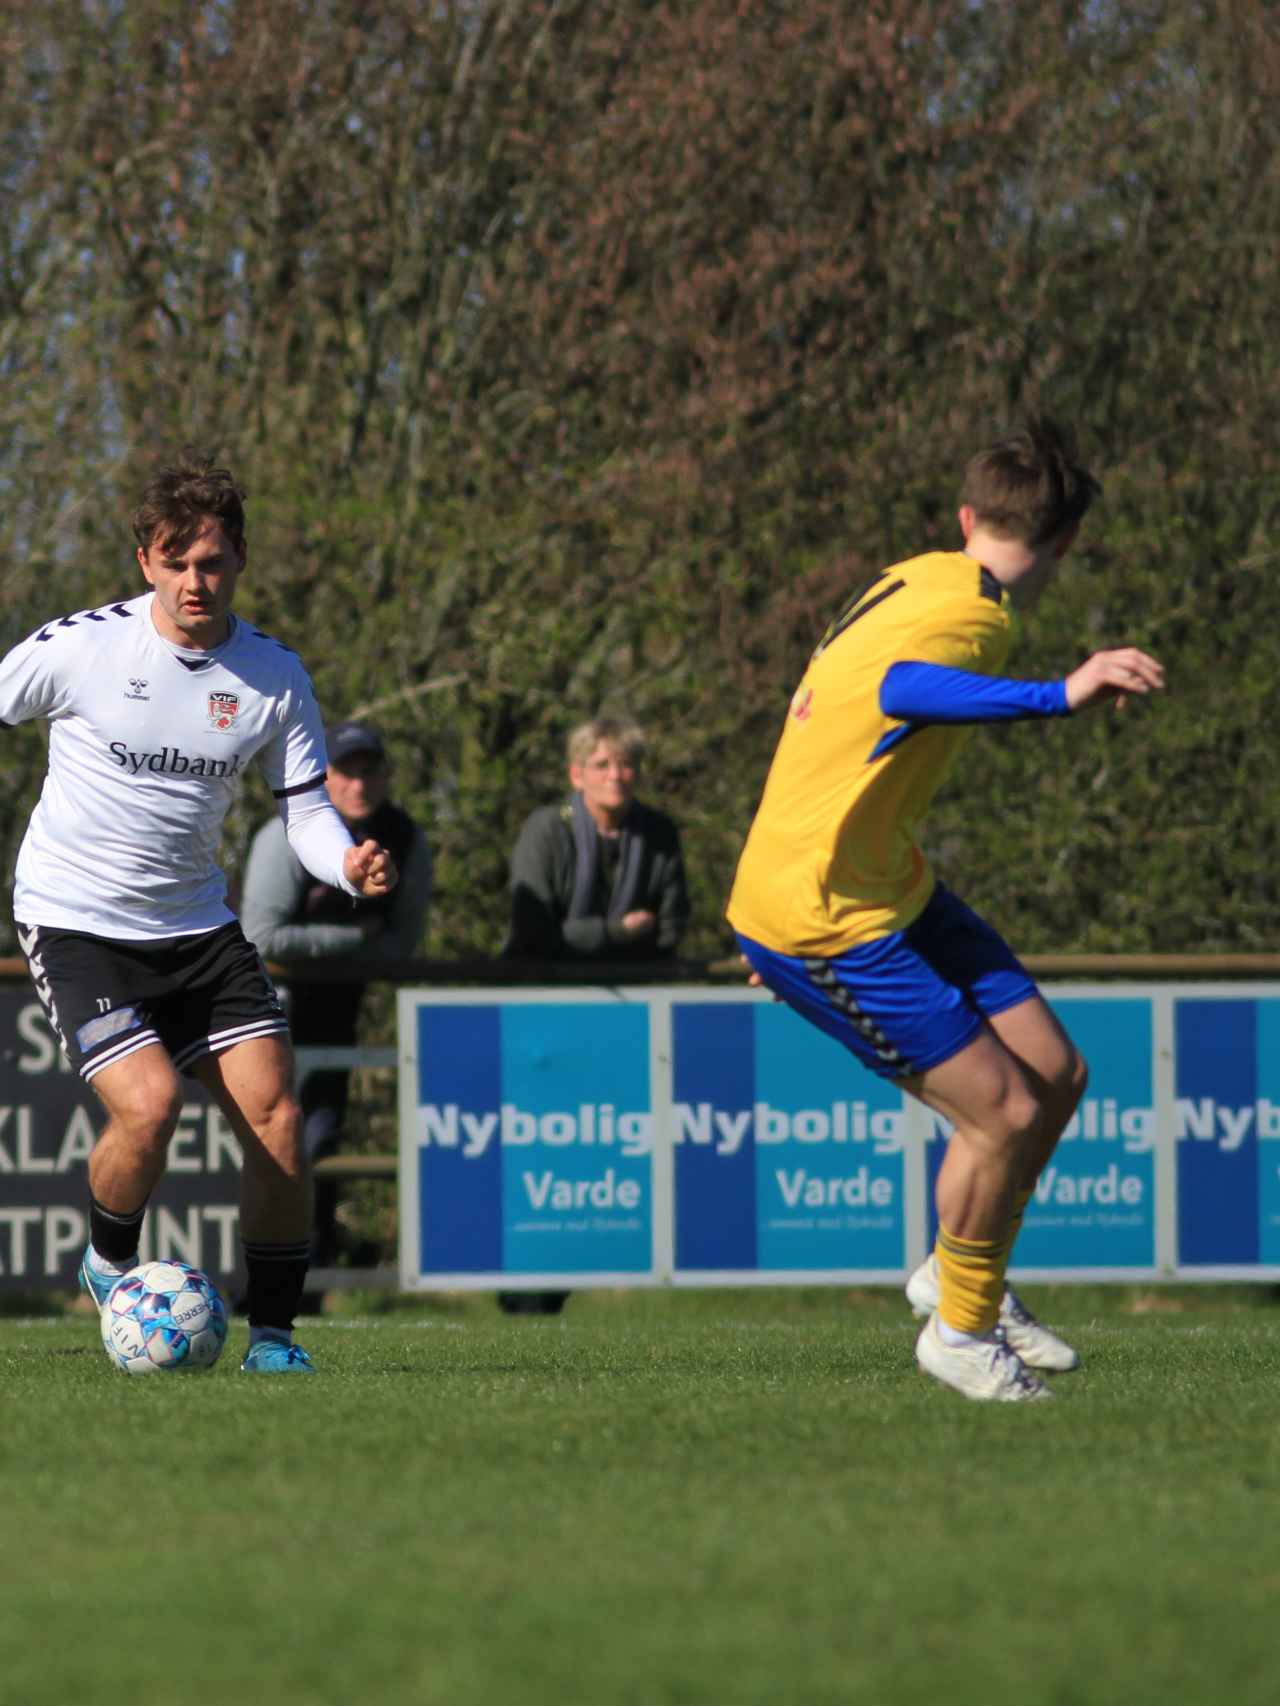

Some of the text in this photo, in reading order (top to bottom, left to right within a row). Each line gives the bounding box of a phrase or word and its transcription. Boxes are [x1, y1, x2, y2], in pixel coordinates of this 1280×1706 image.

[212, 694, 237, 703] VIF
[108, 741, 244, 778] Sydbank
[96, 997, 111, 1014] 11
[417, 1102, 653, 1158] Nybolig
[671, 1100, 907, 1156] Nybolig
[523, 1168, 641, 1210] Varde
[775, 1165, 894, 1207] Varde
[1034, 1163, 1143, 1205] Varde
